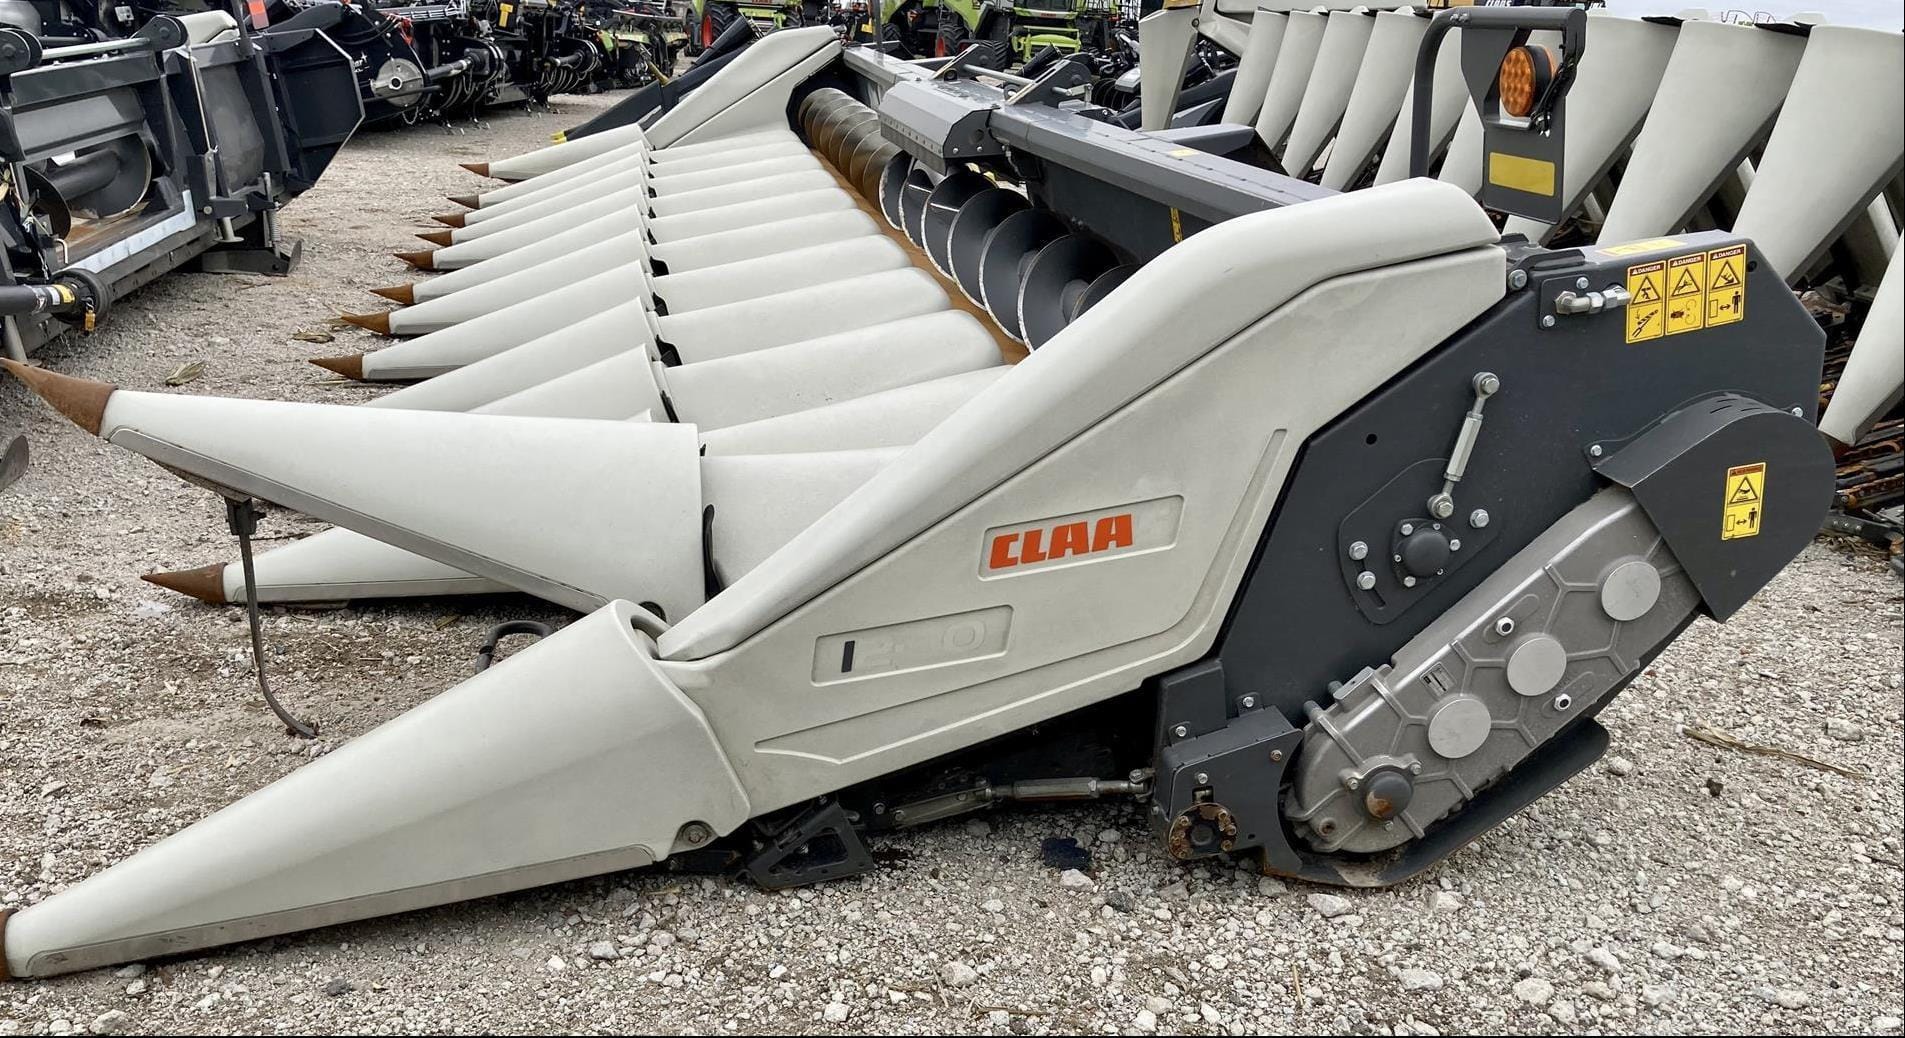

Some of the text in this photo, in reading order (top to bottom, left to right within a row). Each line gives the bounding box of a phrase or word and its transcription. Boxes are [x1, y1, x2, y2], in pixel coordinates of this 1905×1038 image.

[1719, 249, 1741, 257] DANGER
[1678, 256, 1702, 265] DANGER
[1638, 265, 1661, 273] DANGER
[989, 514, 1133, 569] CLAA
